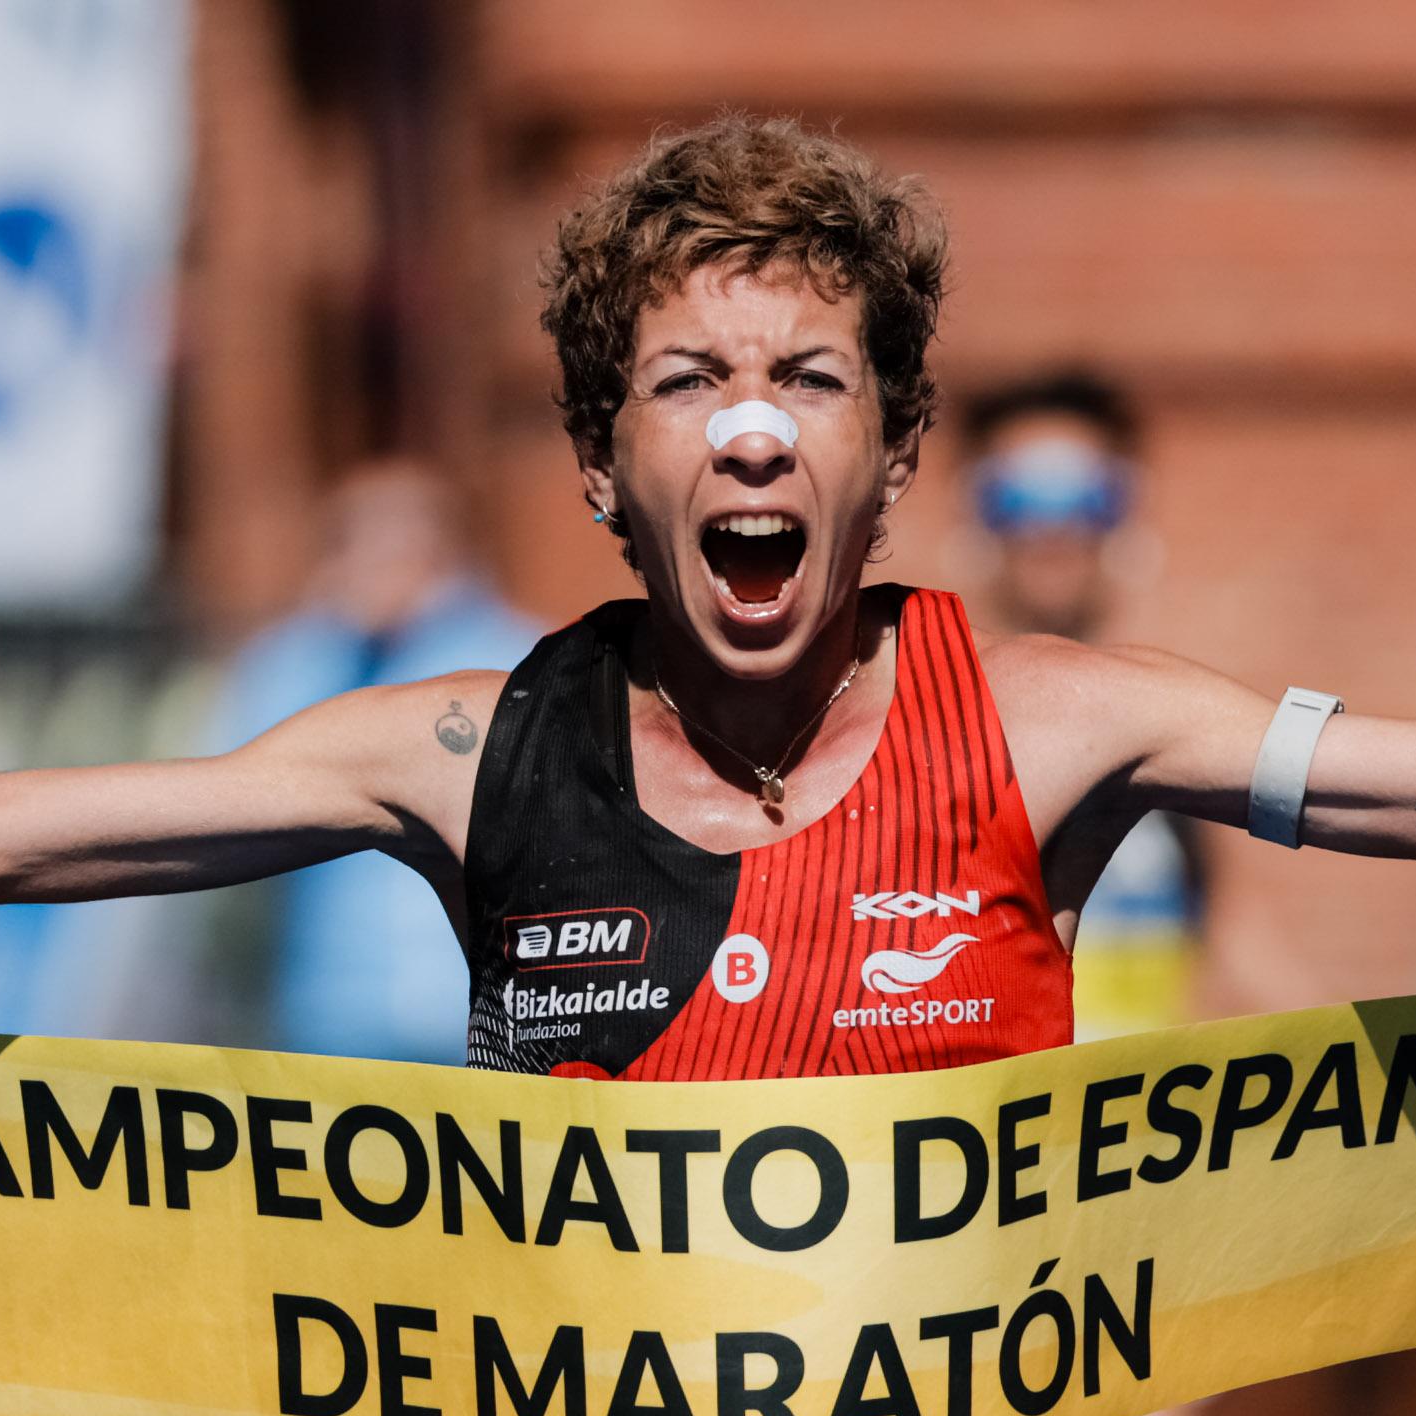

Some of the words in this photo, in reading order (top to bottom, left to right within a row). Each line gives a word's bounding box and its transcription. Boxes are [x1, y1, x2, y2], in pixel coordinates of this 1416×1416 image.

[556, 919, 632, 956] BM
[726, 951, 757, 986] B
[516, 979, 670, 1020] Bizkaialde
[833, 998, 995, 1028] emteSPORT
[516, 1020, 581, 1043] fundazioa
[893, 1092, 1051, 1243] DE
